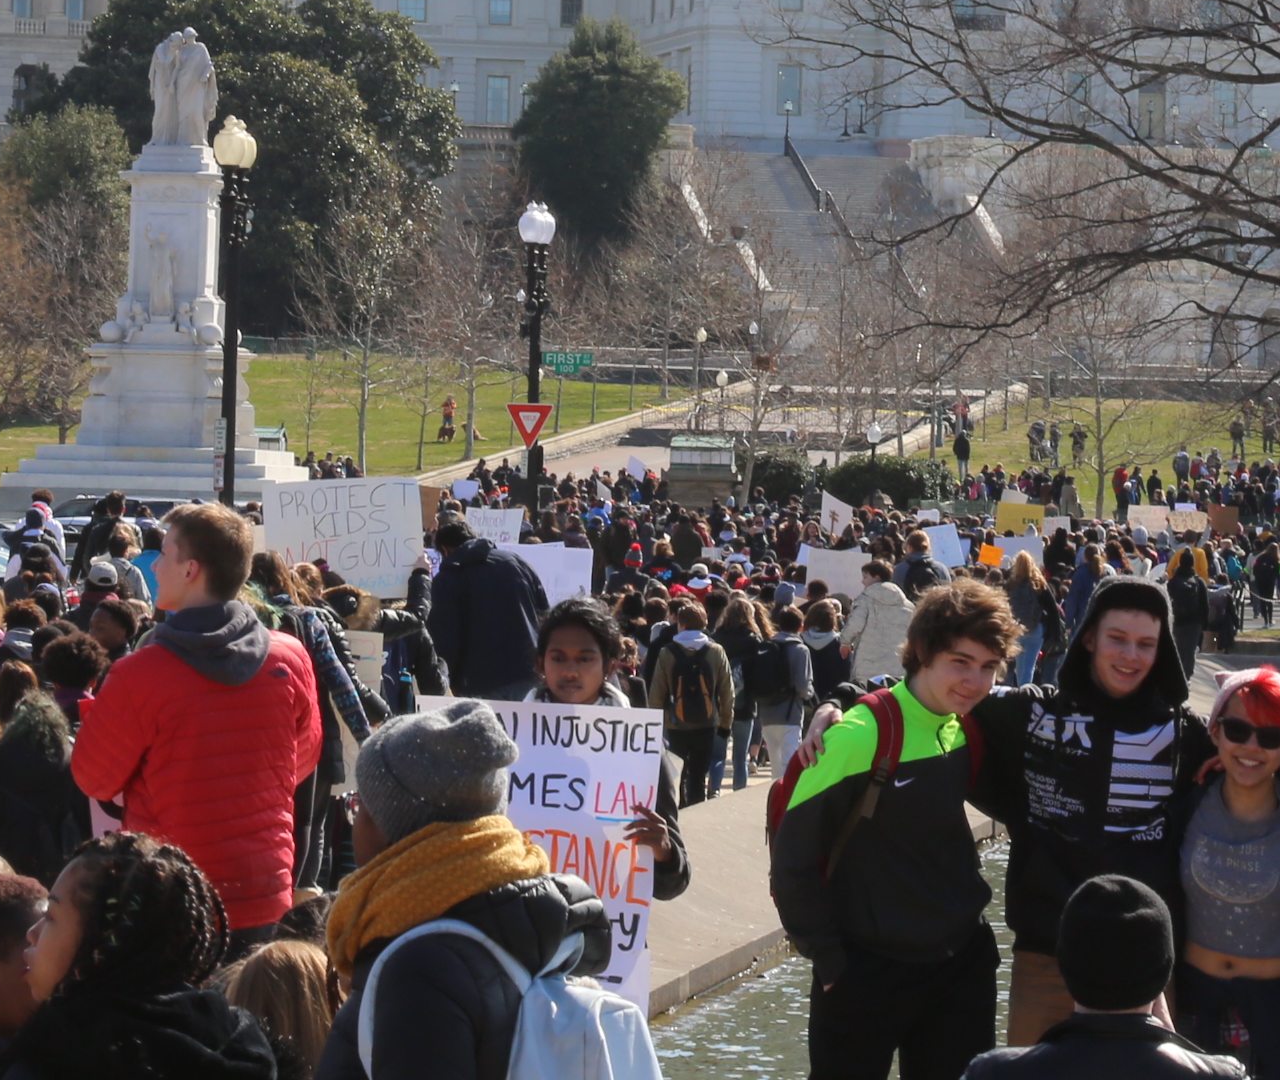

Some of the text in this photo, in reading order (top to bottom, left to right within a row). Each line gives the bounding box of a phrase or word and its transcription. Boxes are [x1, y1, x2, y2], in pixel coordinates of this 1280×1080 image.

[546, 353, 582, 364] FIRST
[279, 482, 415, 519] PROTECT
[313, 509, 391, 539] KIDS
[285, 538, 338, 566] NOT
[338, 537, 418, 571] GUNS
[532, 712, 663, 754] INJUSTICE
[594, 780, 654, 815] LAW
